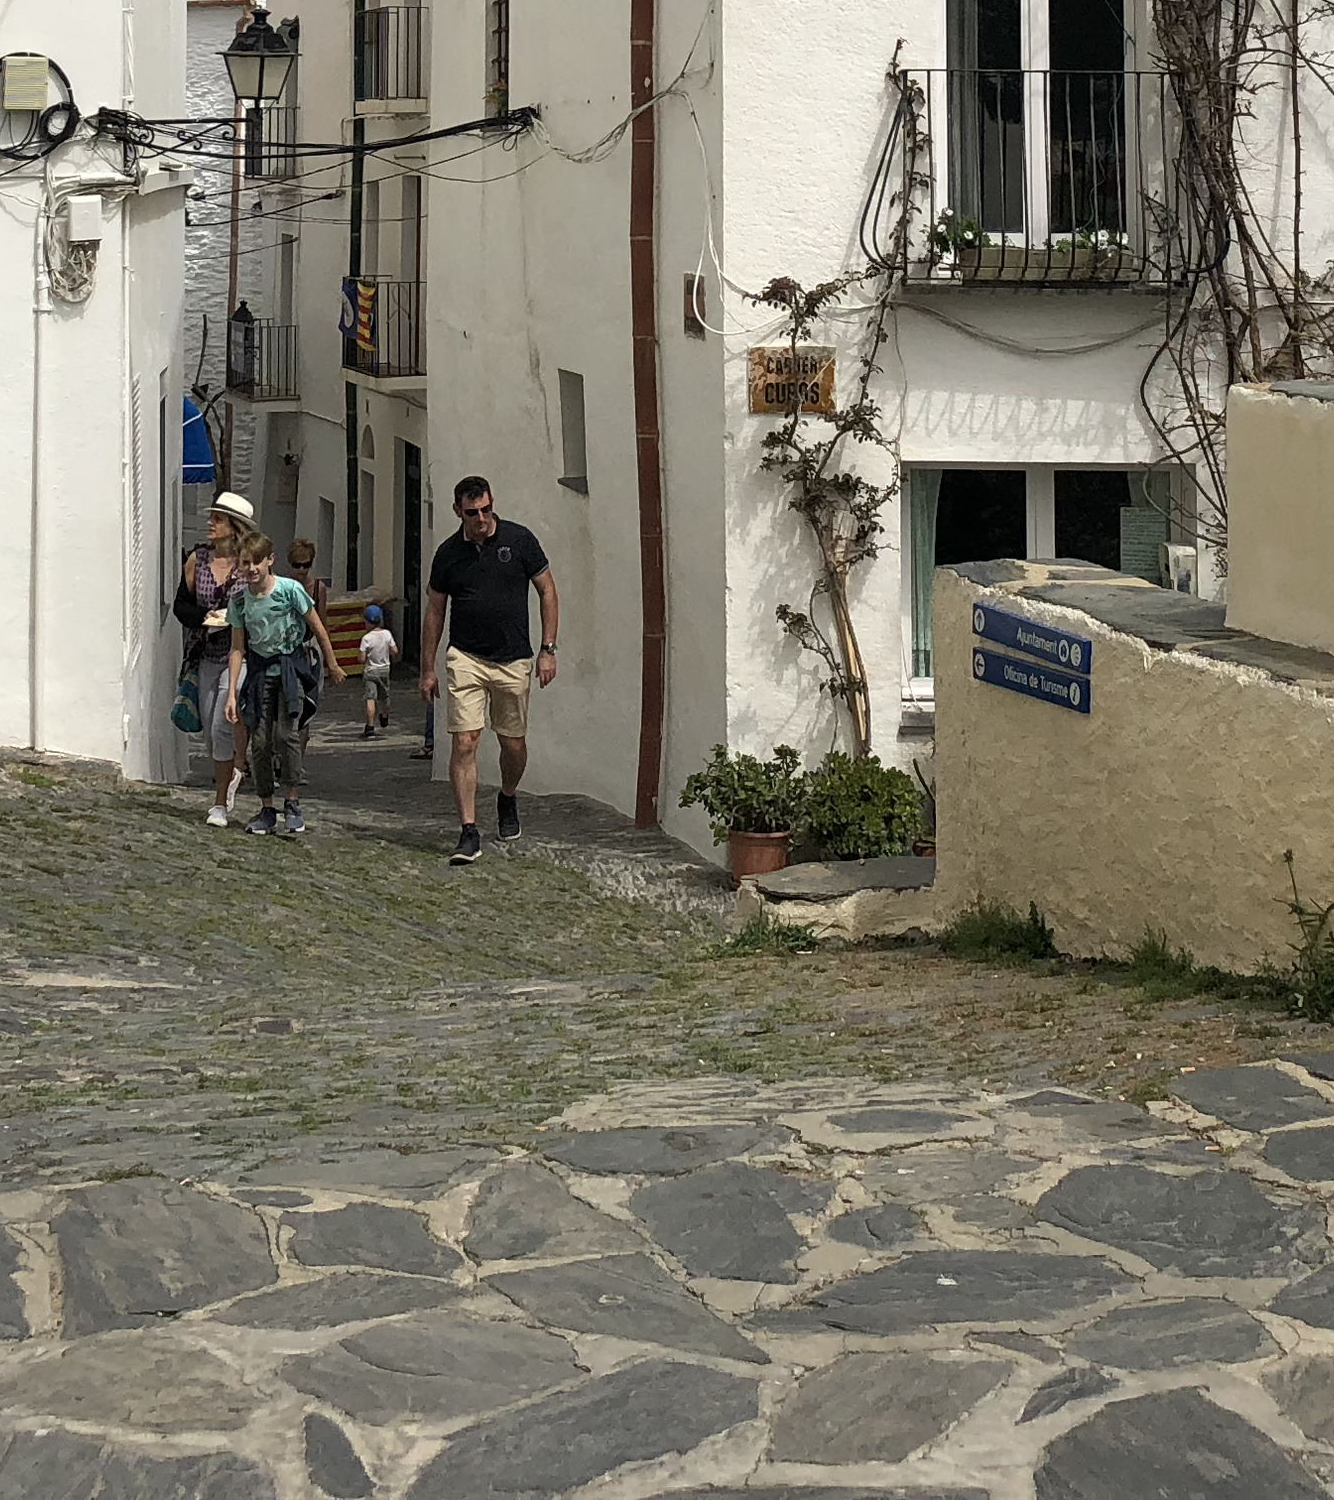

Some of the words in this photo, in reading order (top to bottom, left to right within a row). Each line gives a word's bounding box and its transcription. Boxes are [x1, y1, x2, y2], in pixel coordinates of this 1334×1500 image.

[1003, 664, 1028, 686] Oficina
[1028, 673, 1039, 689] de
[1040, 675, 1069, 699] Turisme
